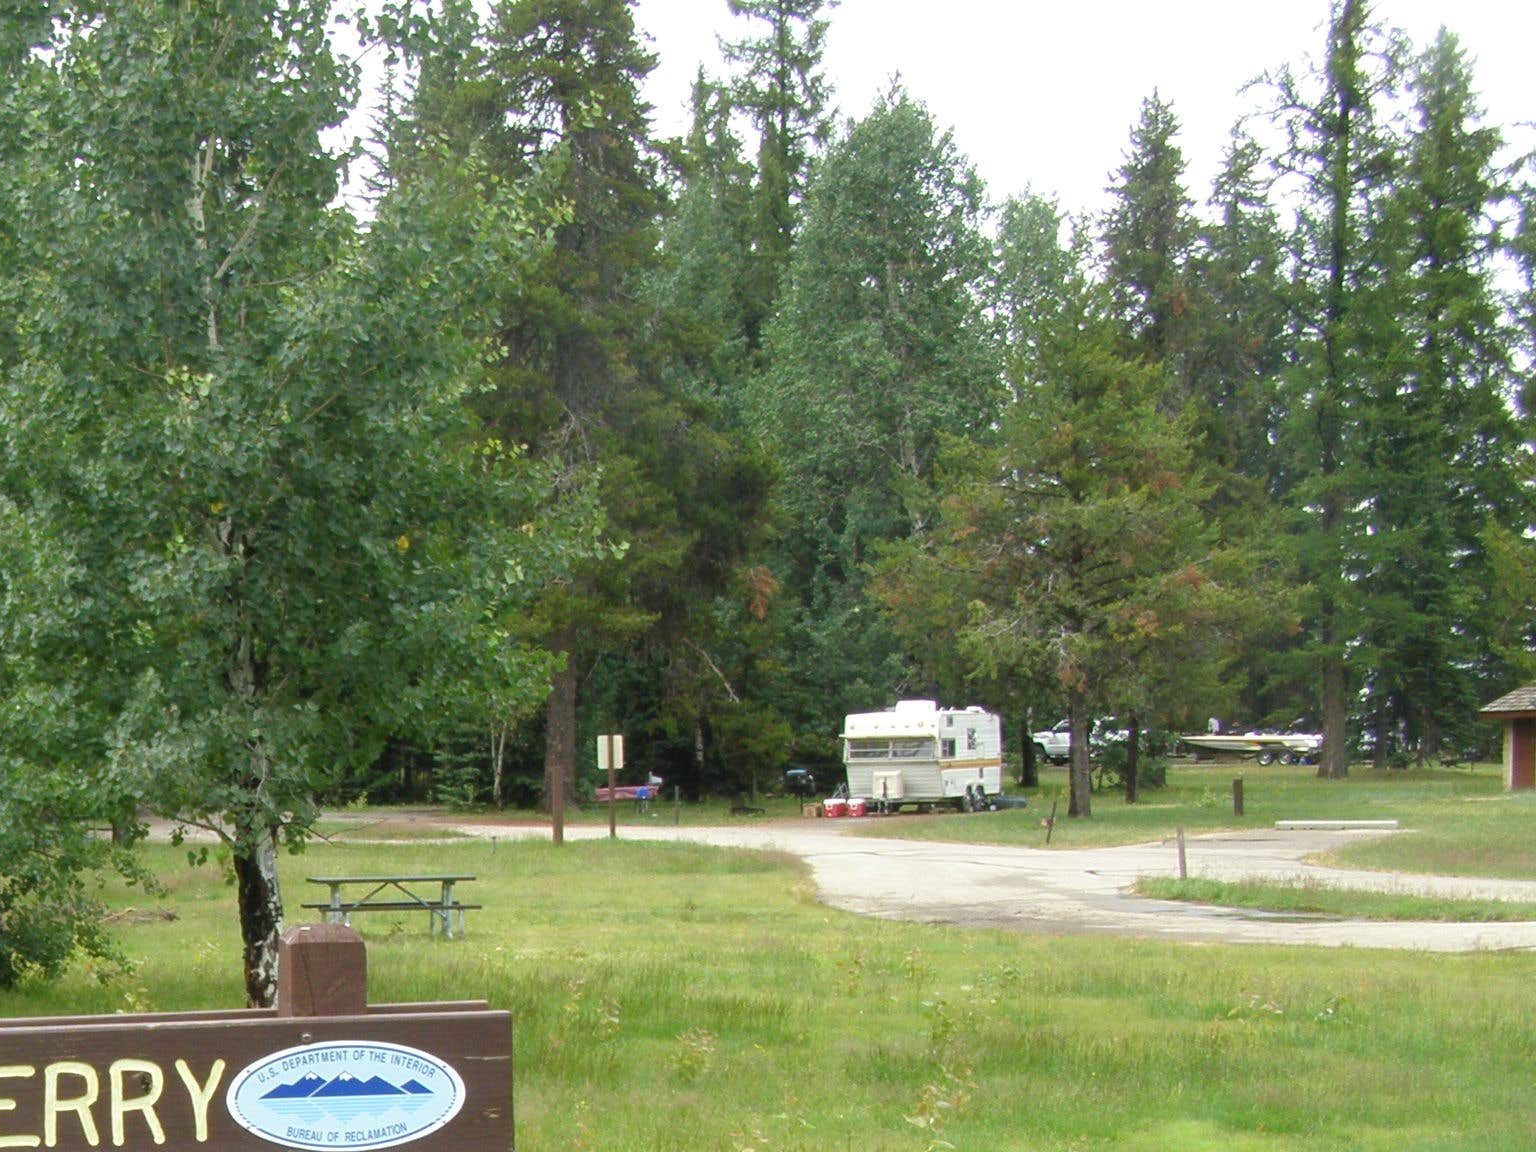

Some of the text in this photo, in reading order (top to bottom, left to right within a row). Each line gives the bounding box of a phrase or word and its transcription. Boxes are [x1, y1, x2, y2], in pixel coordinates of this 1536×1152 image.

[282, 1050, 347, 1071] DEPARTMENT
[353, 1050, 366, 1061] OF
[369, 1051, 386, 1063] THE
[390, 1056, 436, 1078] INTERIOR
[286, 1122, 408, 1142] BUREAU OF RECLAMATION
